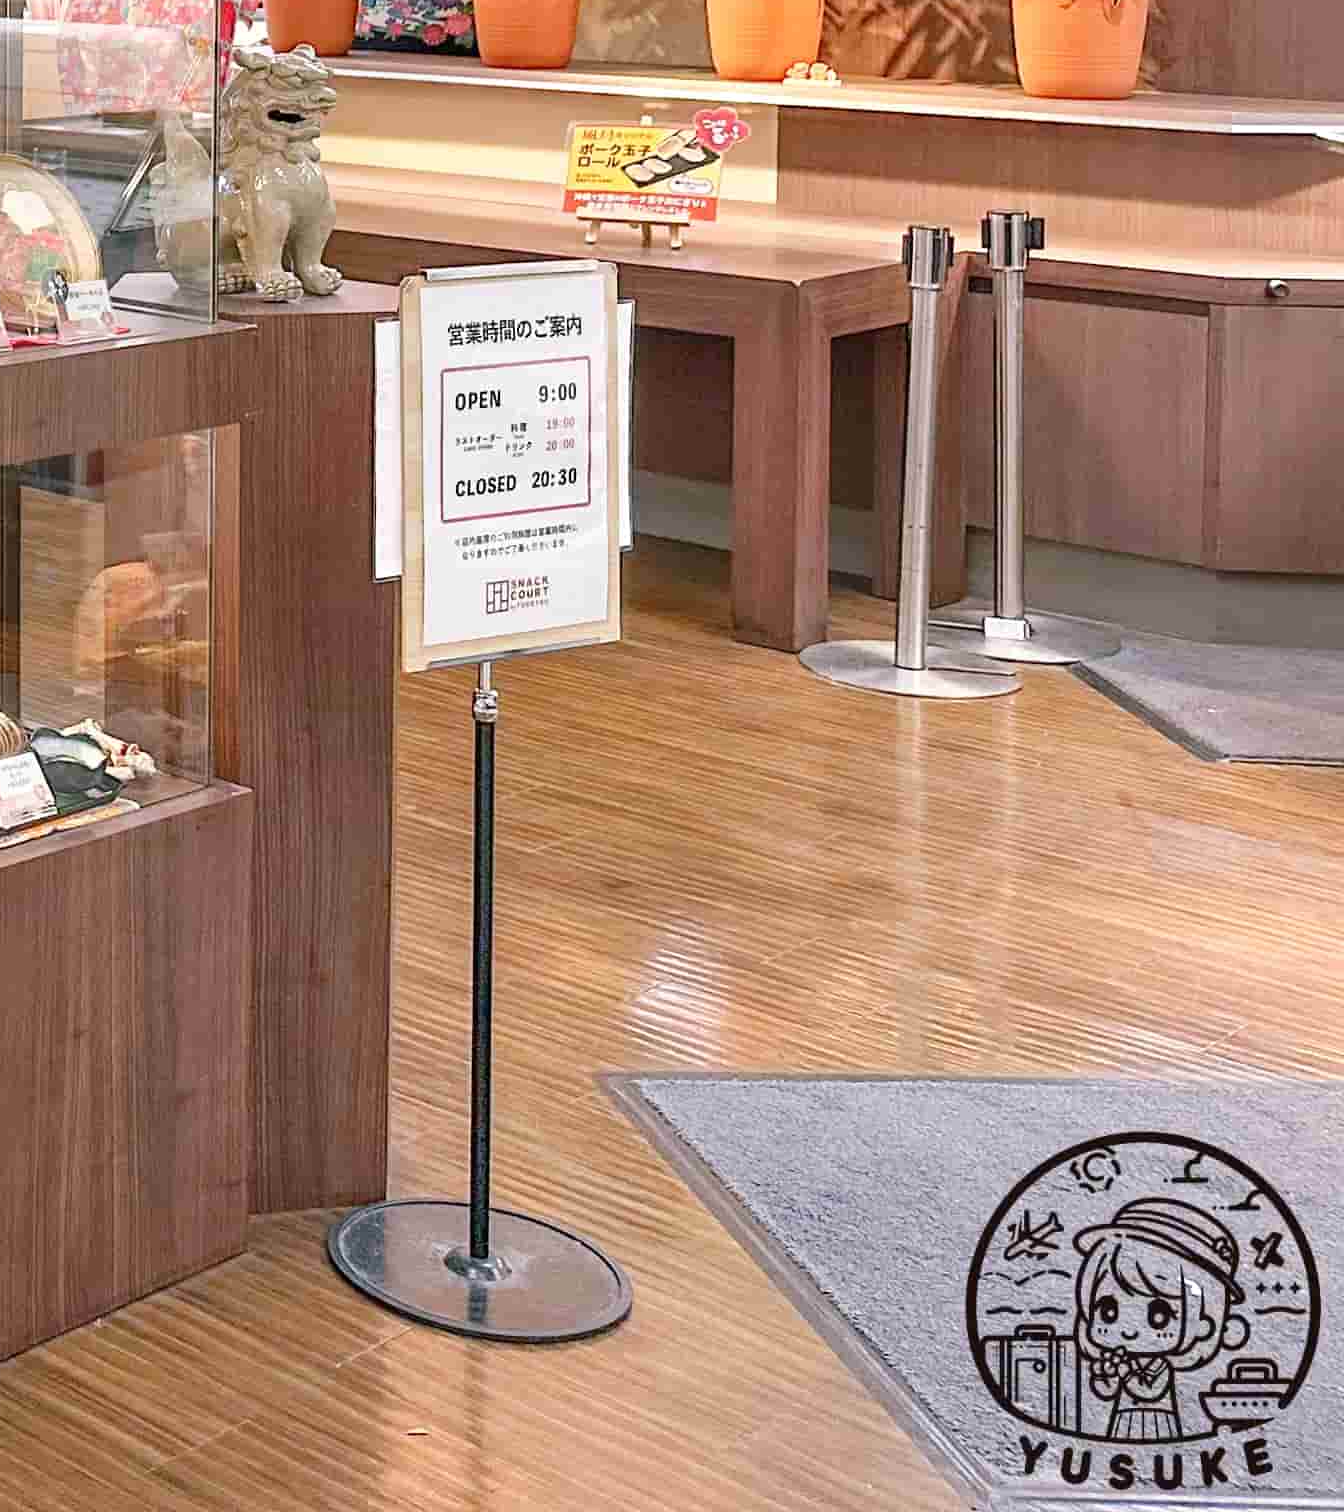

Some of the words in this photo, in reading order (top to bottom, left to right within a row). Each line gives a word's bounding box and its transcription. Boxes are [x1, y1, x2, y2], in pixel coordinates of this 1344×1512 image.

[577, 156, 621, 168] ロール
[447, 314, 583, 347] 営業時間のご案内
[455, 389, 502, 411] OPEN
[538, 382, 578, 404] 9:00
[455, 474, 517, 498] CLOSED
[531, 467, 578, 490] 20:30
[510, 575, 550, 588] SNACK
[510, 586, 550, 601] COURT
